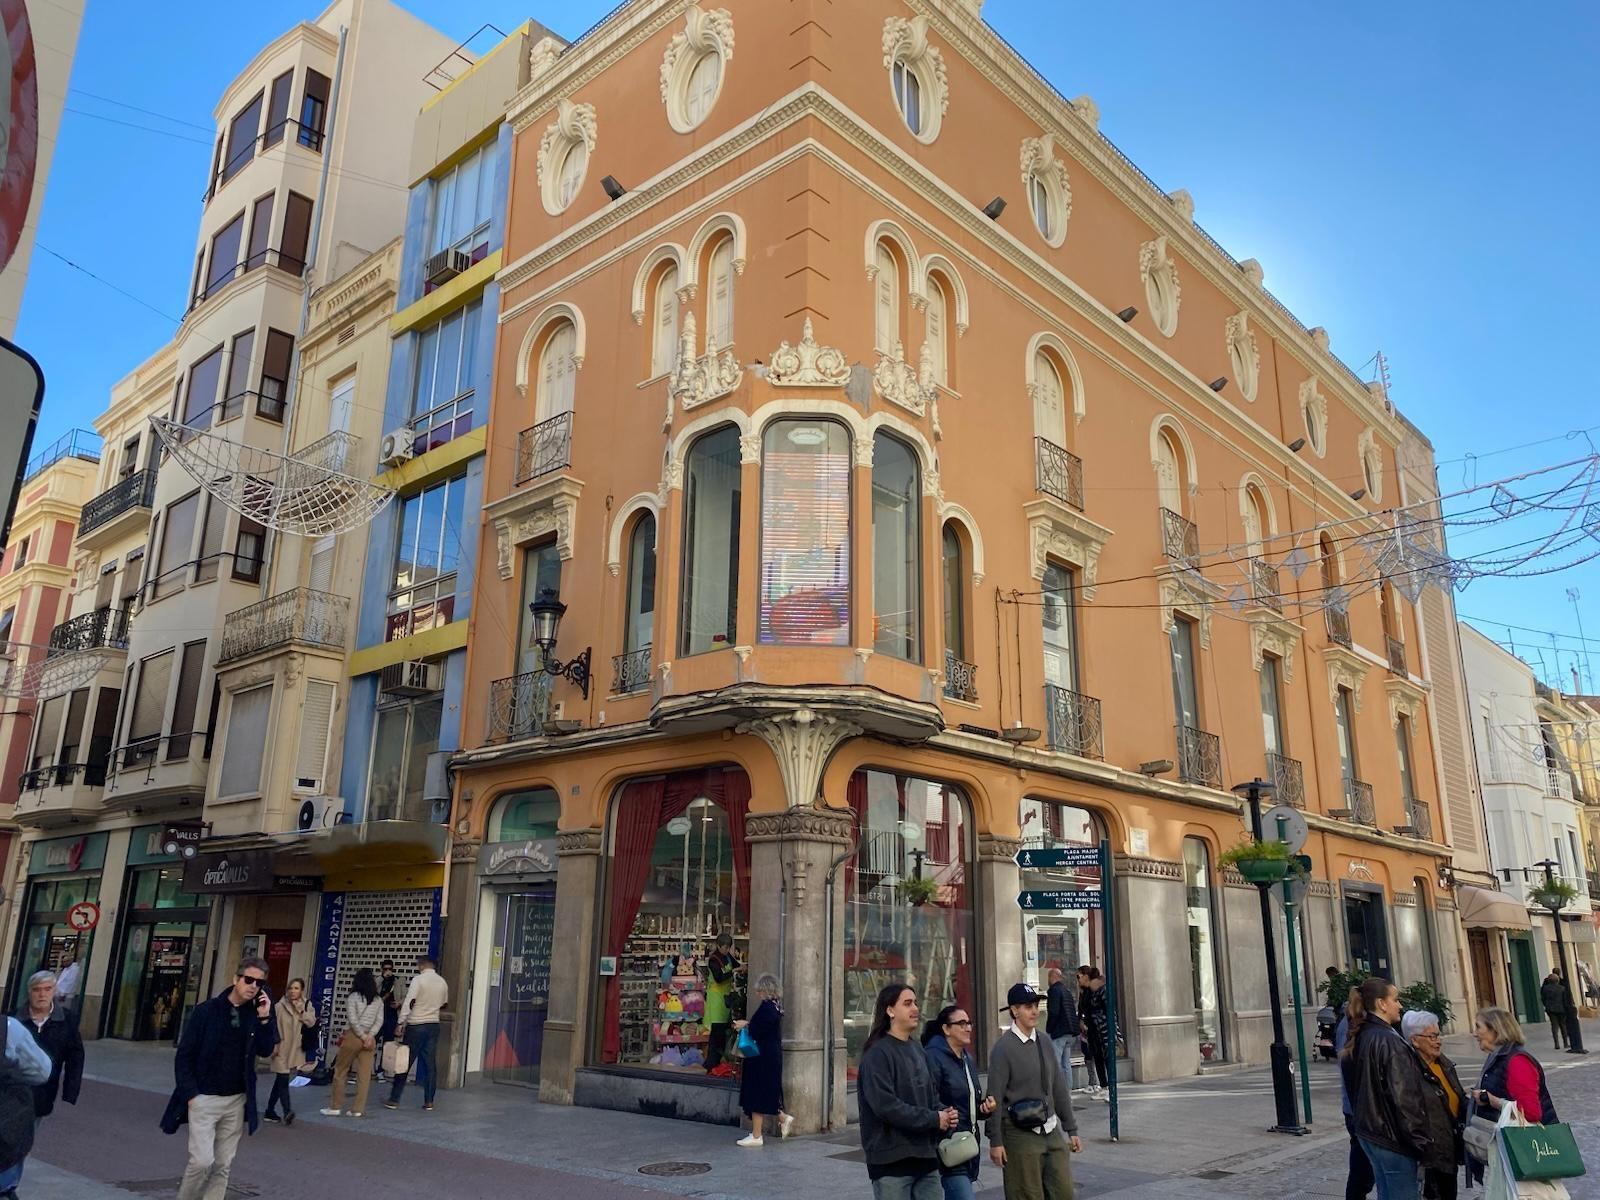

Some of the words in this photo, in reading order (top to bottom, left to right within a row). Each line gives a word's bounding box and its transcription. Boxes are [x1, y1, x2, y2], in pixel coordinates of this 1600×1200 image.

[175, 832, 199, 840] VALLS
[333, 895, 342, 905] 4
[327, 909, 342, 959] PLANTAS
[325, 966, 335, 980] DE
